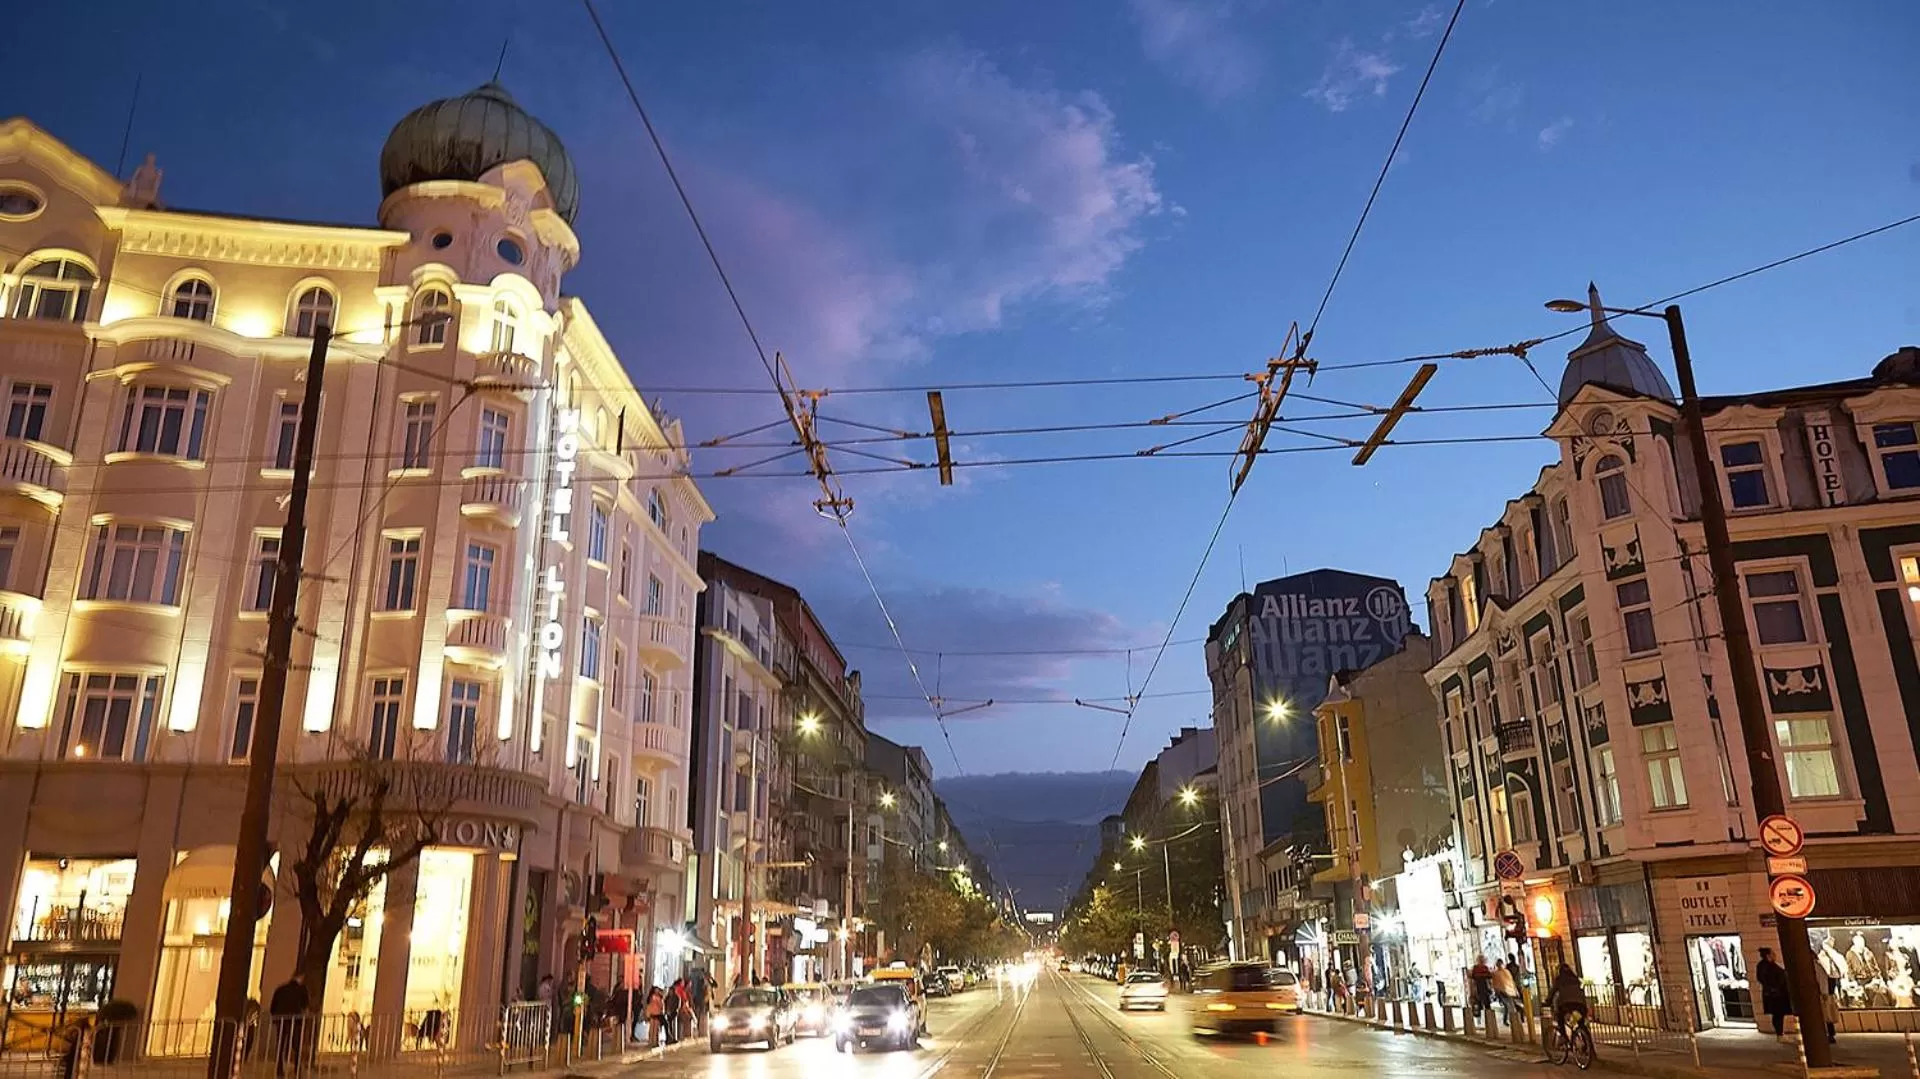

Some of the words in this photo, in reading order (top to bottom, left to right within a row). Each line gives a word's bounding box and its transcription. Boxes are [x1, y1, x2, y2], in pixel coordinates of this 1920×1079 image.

[553, 409, 580, 541] HOTEL
[1813, 425, 1844, 507] HOTEL
[1261, 593, 1360, 618] Allianz
[540, 566, 564, 679] LION
[1681, 895, 1728, 909] OUTLET
[1689, 913, 1728, 927] ITALY
[1844, 918, 1865, 926] Outlet
[1866, 917, 1881, 926] Italy
